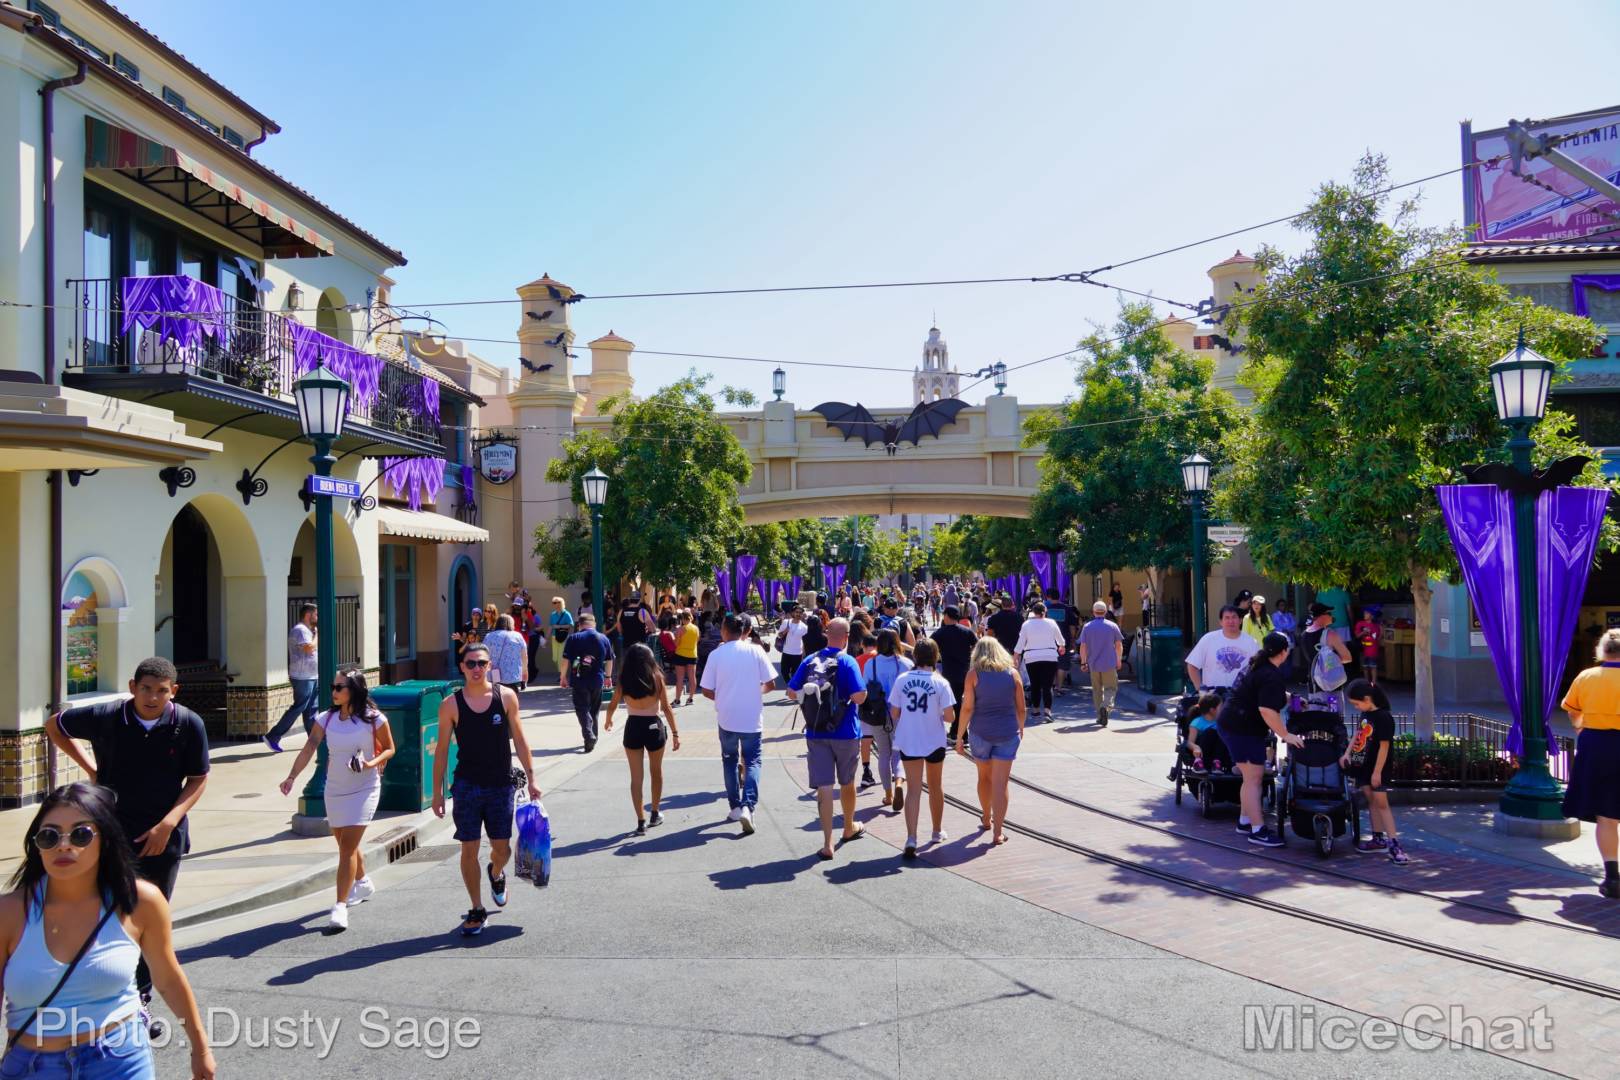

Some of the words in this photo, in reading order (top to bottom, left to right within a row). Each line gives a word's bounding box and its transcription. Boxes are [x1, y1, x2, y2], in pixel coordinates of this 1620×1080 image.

[335, 482, 348, 494] VISTA
[902, 679, 936, 696] HERNANDEZ
[906, 691, 928, 713] 34
